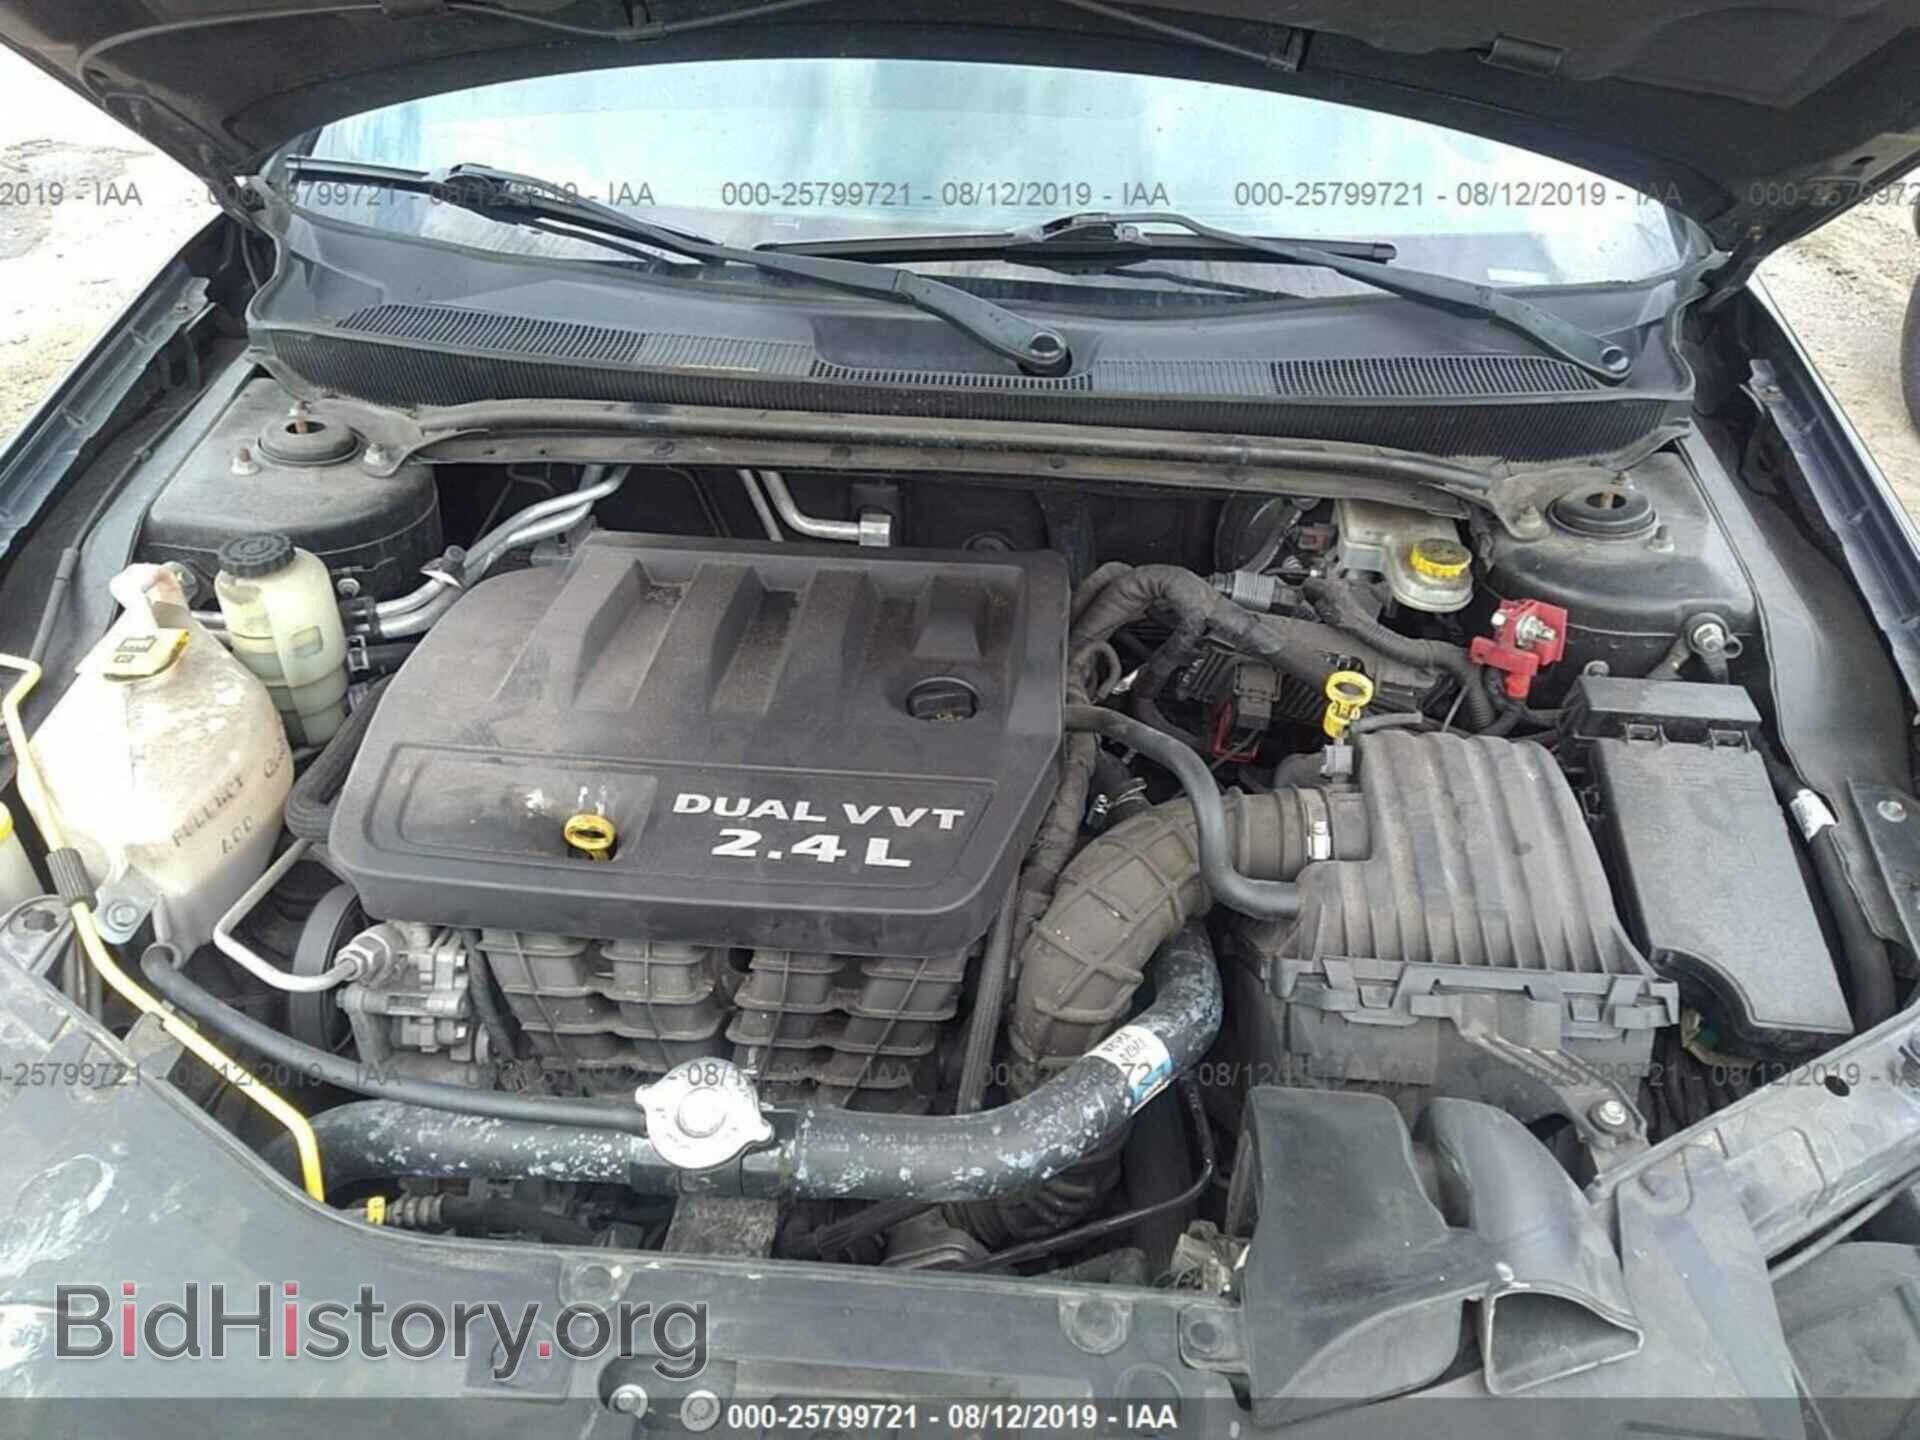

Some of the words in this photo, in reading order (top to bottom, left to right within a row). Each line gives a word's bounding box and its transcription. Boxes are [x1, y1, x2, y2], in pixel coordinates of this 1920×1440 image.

[672, 793, 827, 822] DUAL
[842, 803, 965, 830] VVT
[711, 828, 847, 863] 2.4
[864, 837, 912, 867] L
